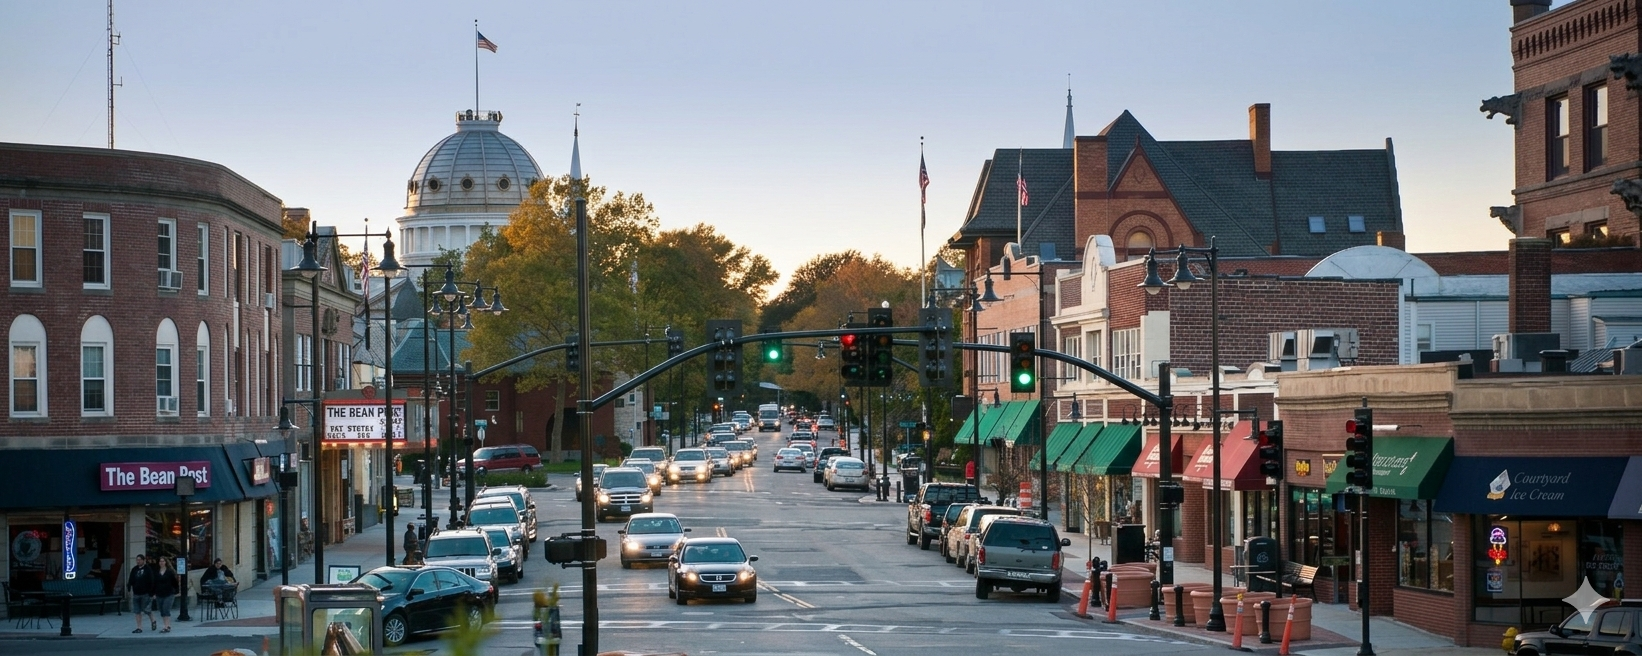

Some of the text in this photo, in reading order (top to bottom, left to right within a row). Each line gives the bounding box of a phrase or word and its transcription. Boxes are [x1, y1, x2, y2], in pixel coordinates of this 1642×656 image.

[327, 407, 346, 417] THE
[349, 407, 374, 417] BEAN
[105, 467, 135, 486] The
[139, 466, 175, 485] Bean
[1514, 472, 1571, 487] Courtyard
[1510, 488, 1564, 500] Ice Cream
